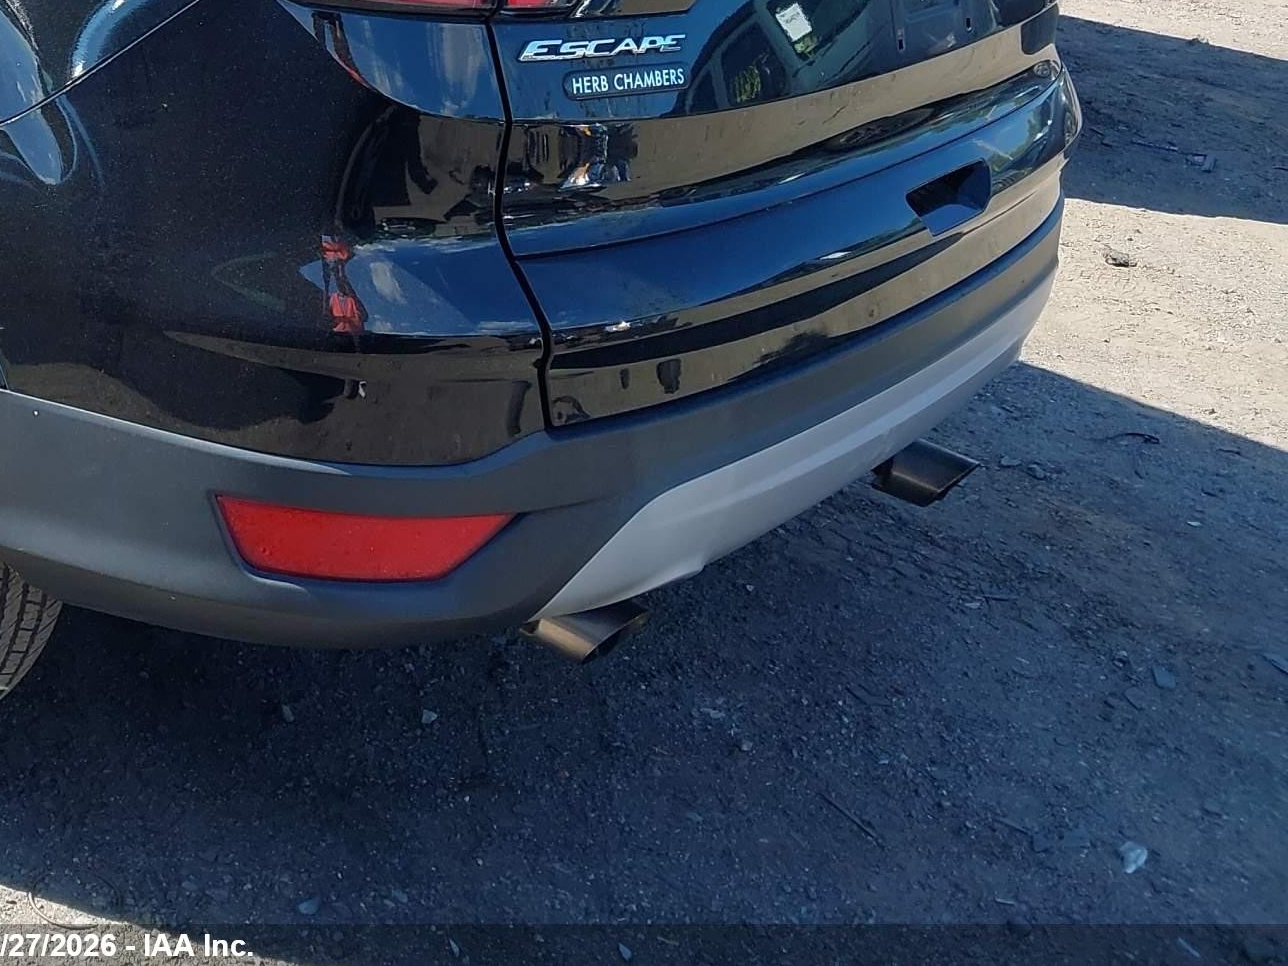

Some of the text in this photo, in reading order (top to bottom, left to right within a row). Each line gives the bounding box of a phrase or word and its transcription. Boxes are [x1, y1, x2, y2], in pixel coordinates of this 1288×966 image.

[519, 33, 686, 62] ESCAPE
[572, 68, 685, 94] HERB CHAMBERS
